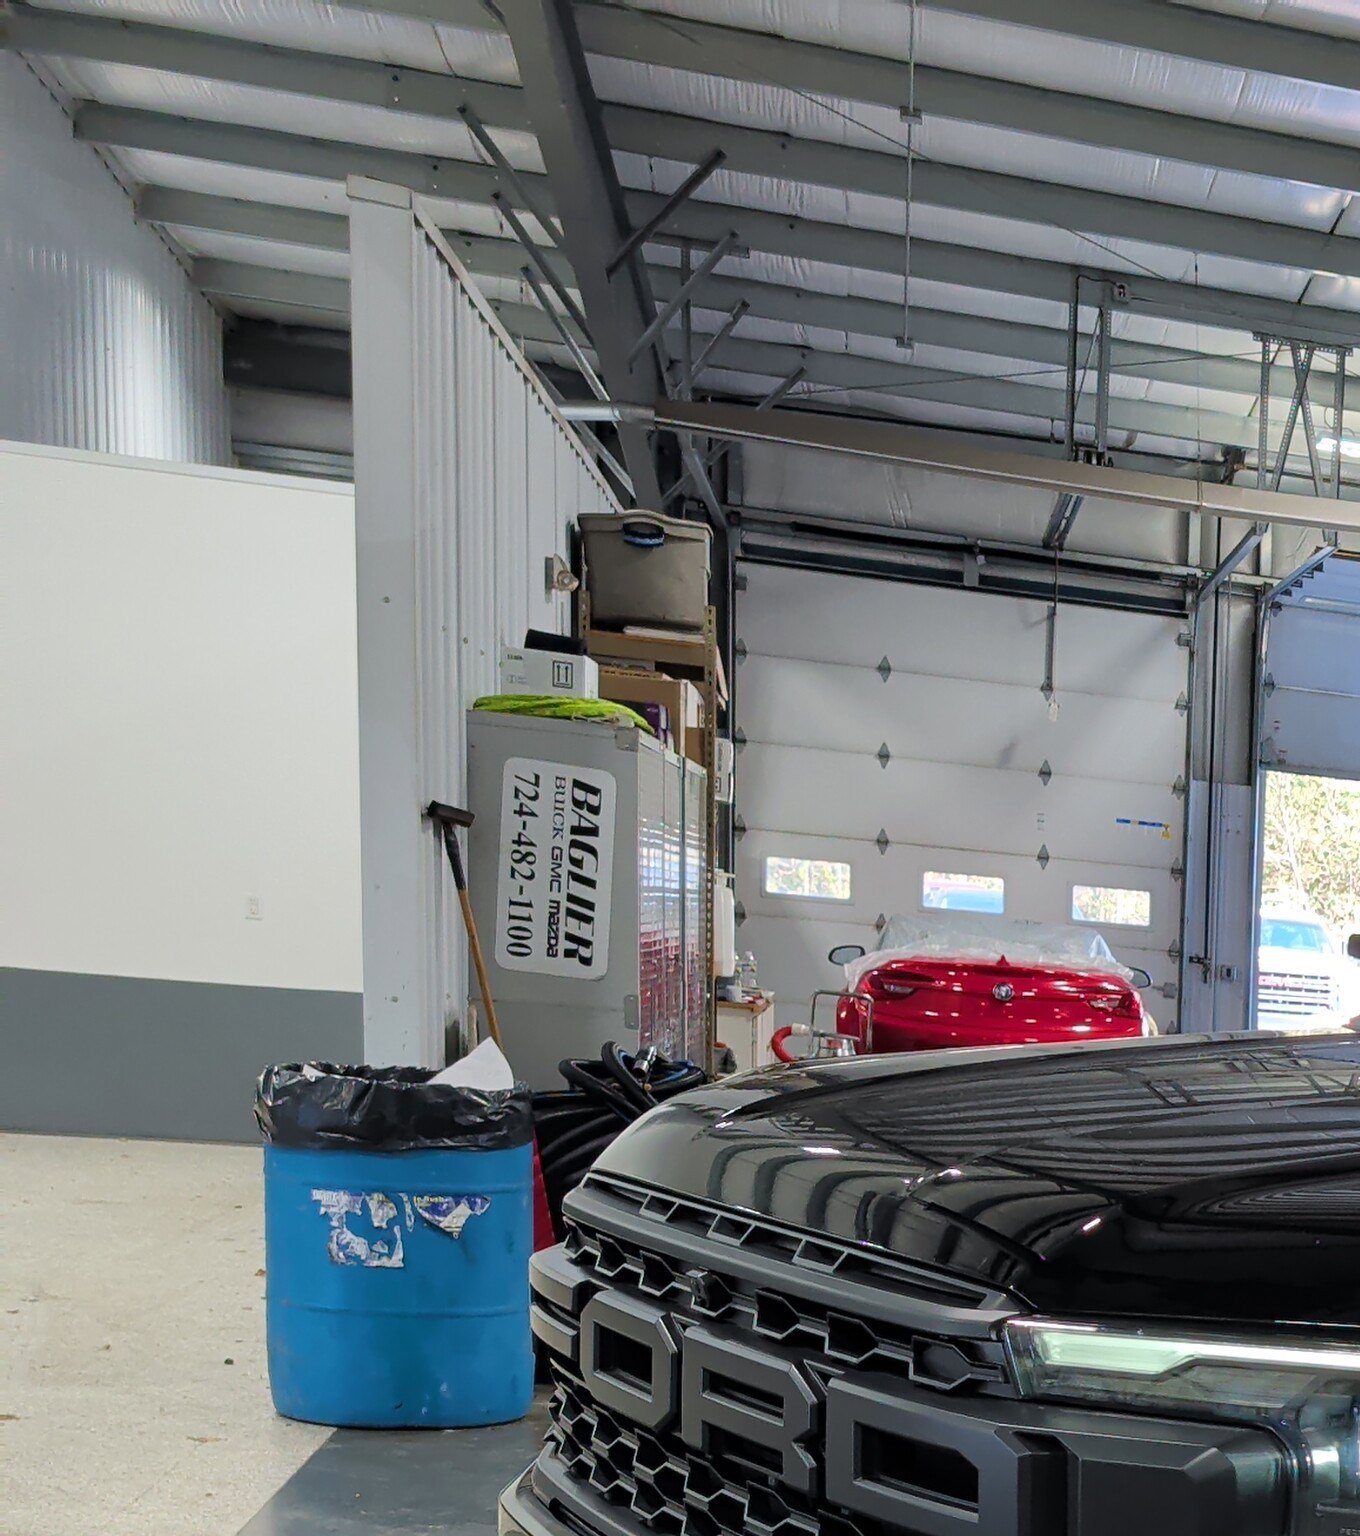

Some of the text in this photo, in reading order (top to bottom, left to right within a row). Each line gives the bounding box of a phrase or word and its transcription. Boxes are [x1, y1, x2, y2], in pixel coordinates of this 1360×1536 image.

[506, 771, 541, 958] 724-482-1100
[550, 846, 563, 893] GMC
[552, 775, 567, 840] BUICK
[564, 778, 602, 967] BAGLIER
